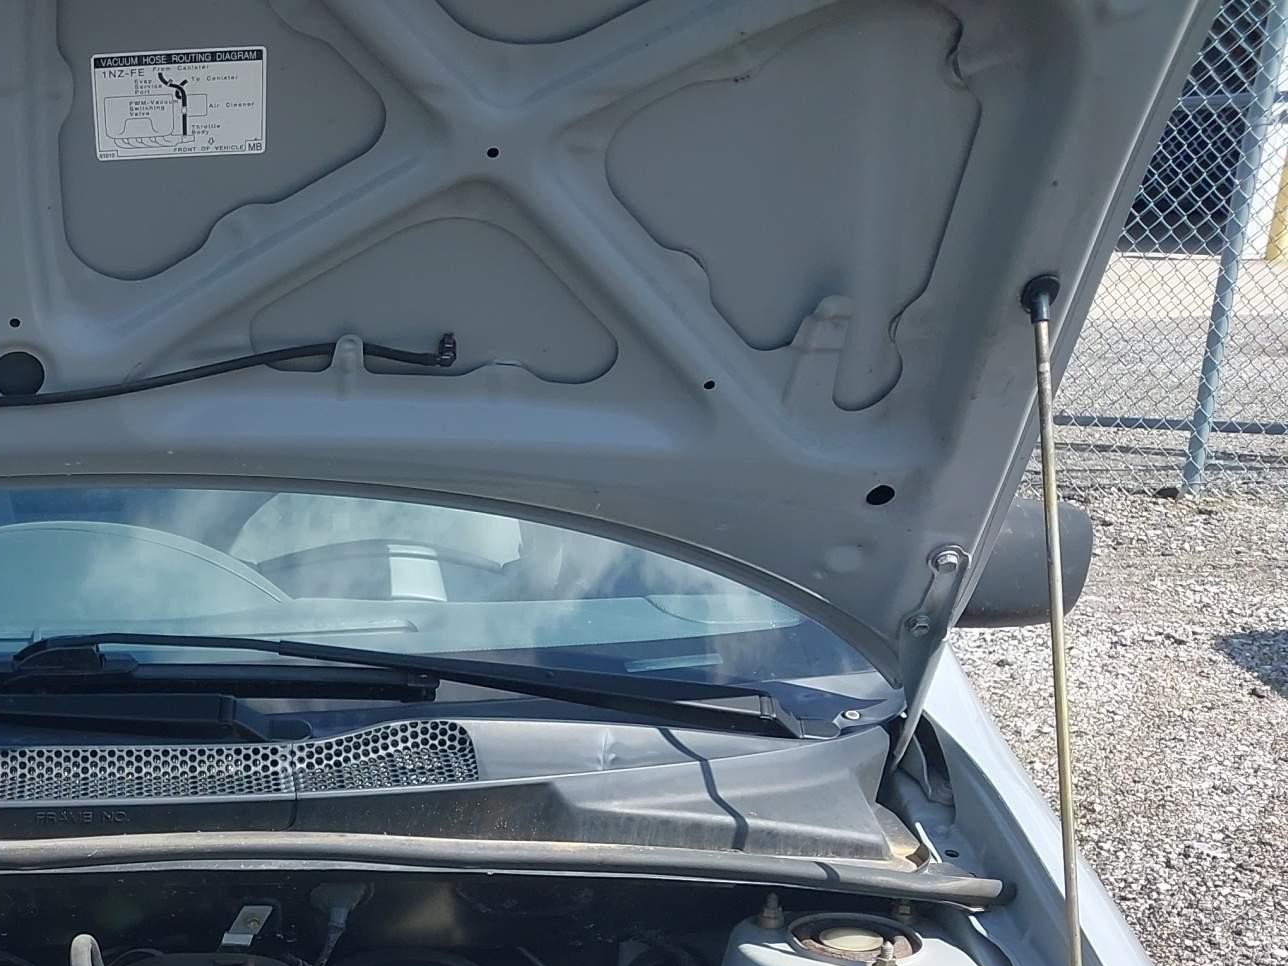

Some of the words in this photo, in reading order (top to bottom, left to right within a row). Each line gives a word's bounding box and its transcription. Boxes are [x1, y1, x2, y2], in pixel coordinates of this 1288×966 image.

[101, 56, 138, 66] VACUUM
[142, 54, 167, 64] HOSE
[172, 53, 212, 63] ROUTING
[216, 50, 257, 60] DIAGRAM
[102, 68, 145, 78] 1NZ-FE
[248, 142, 263, 151] MB
